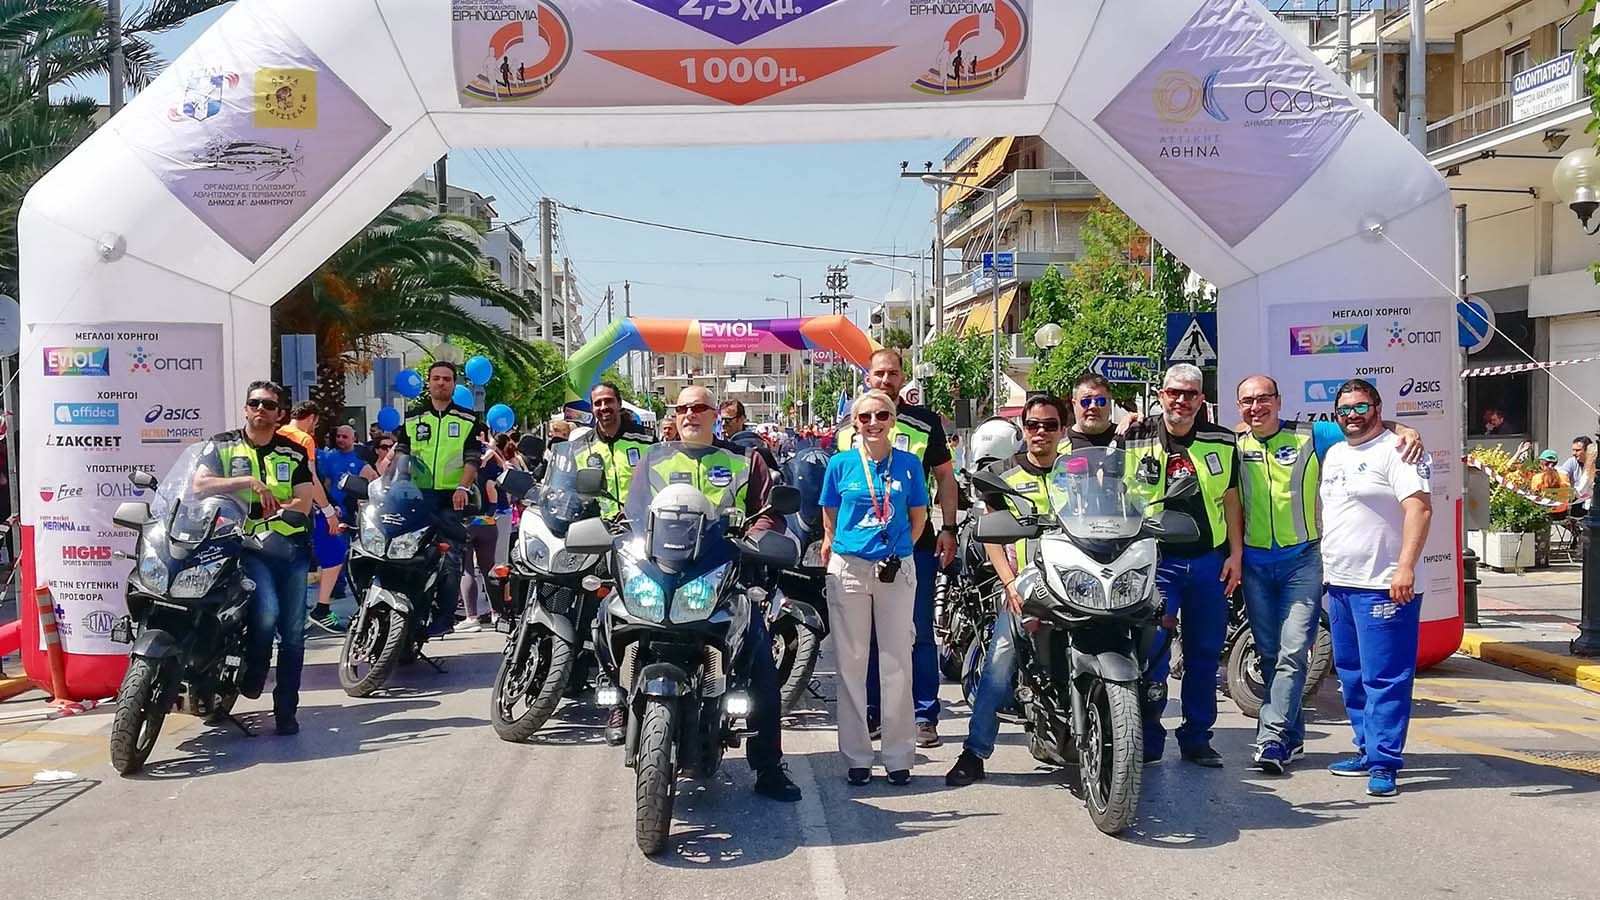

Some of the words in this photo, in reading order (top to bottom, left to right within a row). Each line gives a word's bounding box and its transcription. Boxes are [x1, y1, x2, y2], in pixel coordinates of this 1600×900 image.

[910, 3, 994, 15] ΕΙΡΗΝΟΔΡΟΜΙΑ
[453, 10, 538, 21] ΕΙΡΗΝΟΔΡΟΜΙΑ
[1515, 58, 1570, 92] ΟΔΟΝΤΙΑΤΡΕΙΟ
[1159, 146, 1220, 158] ΑΘΗΝΑ
[207, 199, 234, 207] ΔΗΜΟΣ
[250, 198, 294, 206] ΔΗΜΗΤΡΙΟΥ
[1332, 310, 1373, 319] ΜΕΓΑΛΟΙ
[1375, 307, 1412, 317] ΧΟΡΗΓΟΙ
[701, 322, 760, 338] EVIOL
[76, 332, 114, 341] ΜΕΓΑΛΟΙ
[117, 332, 159, 341] ΧΟΡΗΓΟΙ
[1298, 328, 1359, 347] EVIOL
[48, 351, 101, 369] EVIOL
[1106, 369, 1129, 378] TOWN
[1355, 366, 1395, 376] ΧΟΡΗΓΟΙ
[97, 391, 138, 400] ΧΟΡΗΓΟΙ
[72, 407, 115, 418] affidea
[164, 408, 200, 421] asics
[86, 465, 155, 473] ΥΠΟΣΤΗΡΙΚΤΕΣ
[59, 580, 74, 589] ΤΗΝ
[76, 581, 119, 590] ΕΥΓΕΝΙΚΗ
[59, 592, 104, 601] ΠΡΟΣΦΟΡΑ
